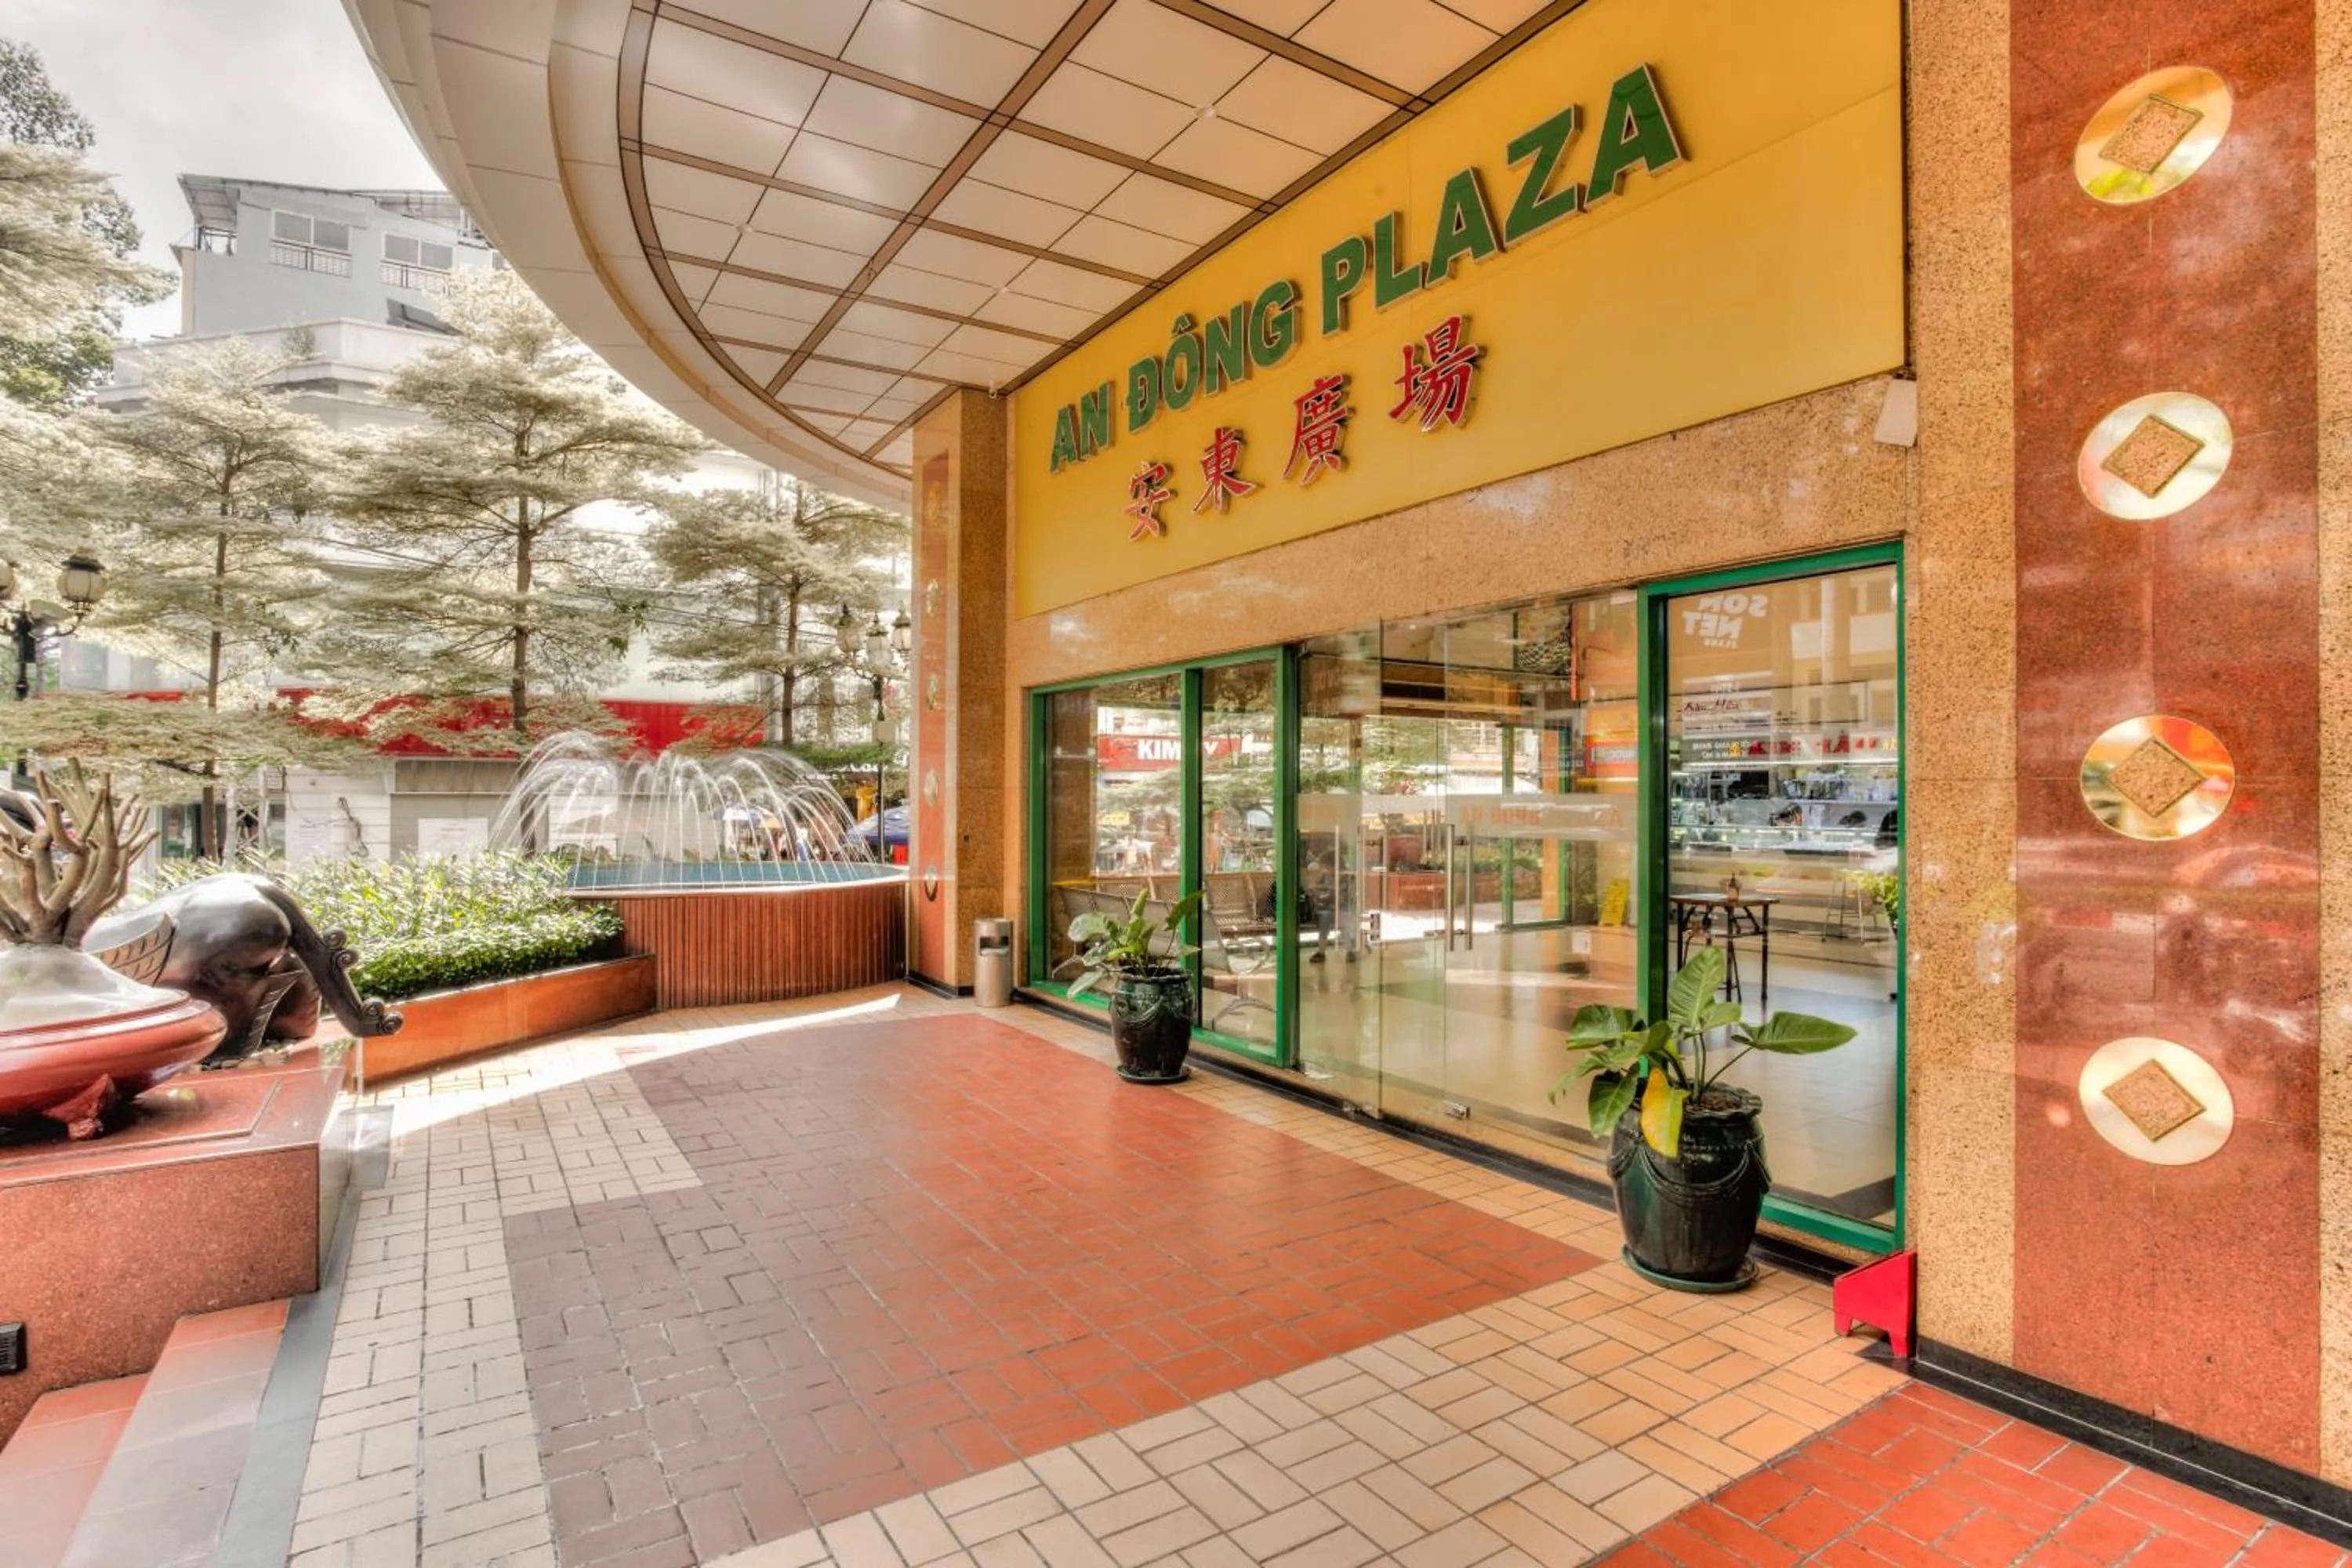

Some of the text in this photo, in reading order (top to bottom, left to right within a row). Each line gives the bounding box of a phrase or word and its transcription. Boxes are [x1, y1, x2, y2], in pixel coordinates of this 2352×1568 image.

[1050, 62, 1690, 476] AN ĐÔNG PLAZA
[1121, 314, 1483, 542] 安東廣場
